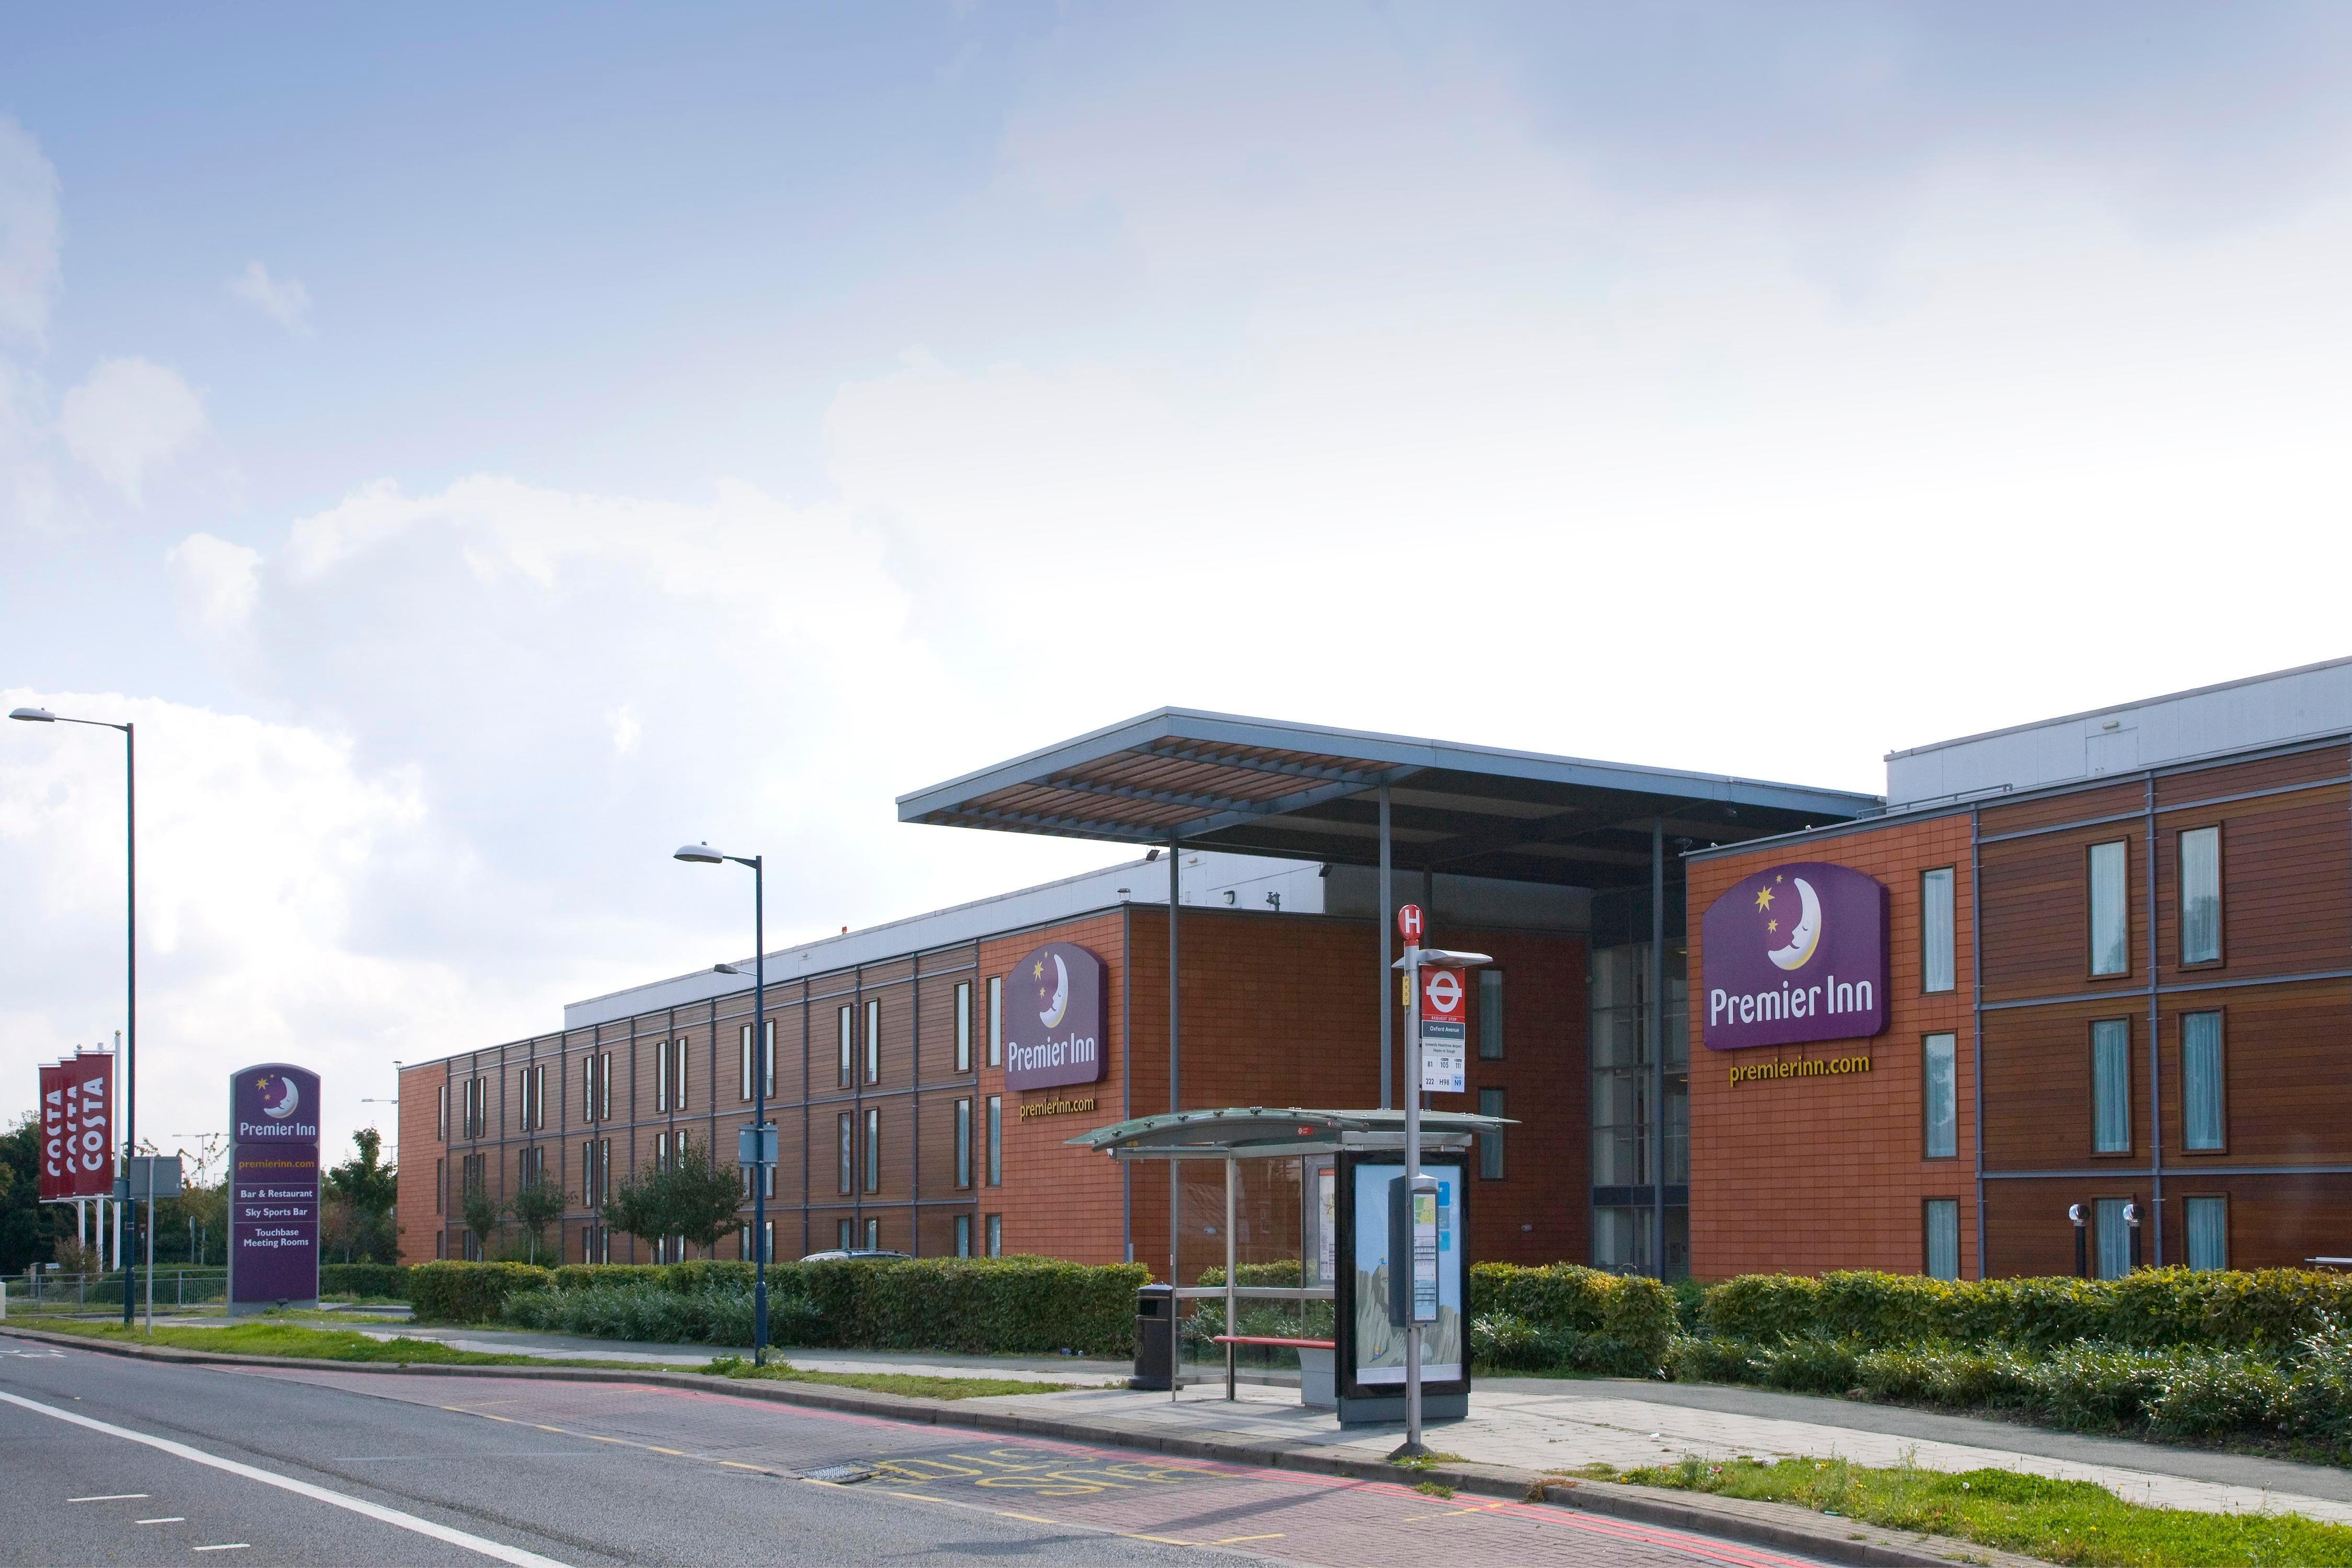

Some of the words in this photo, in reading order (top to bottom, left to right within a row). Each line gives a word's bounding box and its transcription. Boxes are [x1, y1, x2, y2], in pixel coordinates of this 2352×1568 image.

[1405, 909, 1420, 933] H
[1711, 981, 1821, 1027] Premier
[1827, 975, 1872, 1014] Inn
[1009, 1036, 1068, 1072] Premier
[1071, 1032, 1094, 1064] Inn
[1730, 1055, 1870, 1088] premierinn.com
[1020, 1097, 1094, 1122] premierinn.com
[83, 1077, 106, 1171] COSTA
[240, 1122, 294, 1136] Premier
[296, 1123, 316, 1136] Inn
[239, 1159, 314, 1170] premierinn.com
[246, 1208, 261, 1218] Sky
[263, 1208, 291, 1218] Sports
[244, 1239, 279, 1248] Meeting
[255, 1228, 299, 1237] Touchbase
[974, 1462, 1242, 1495] BUS
